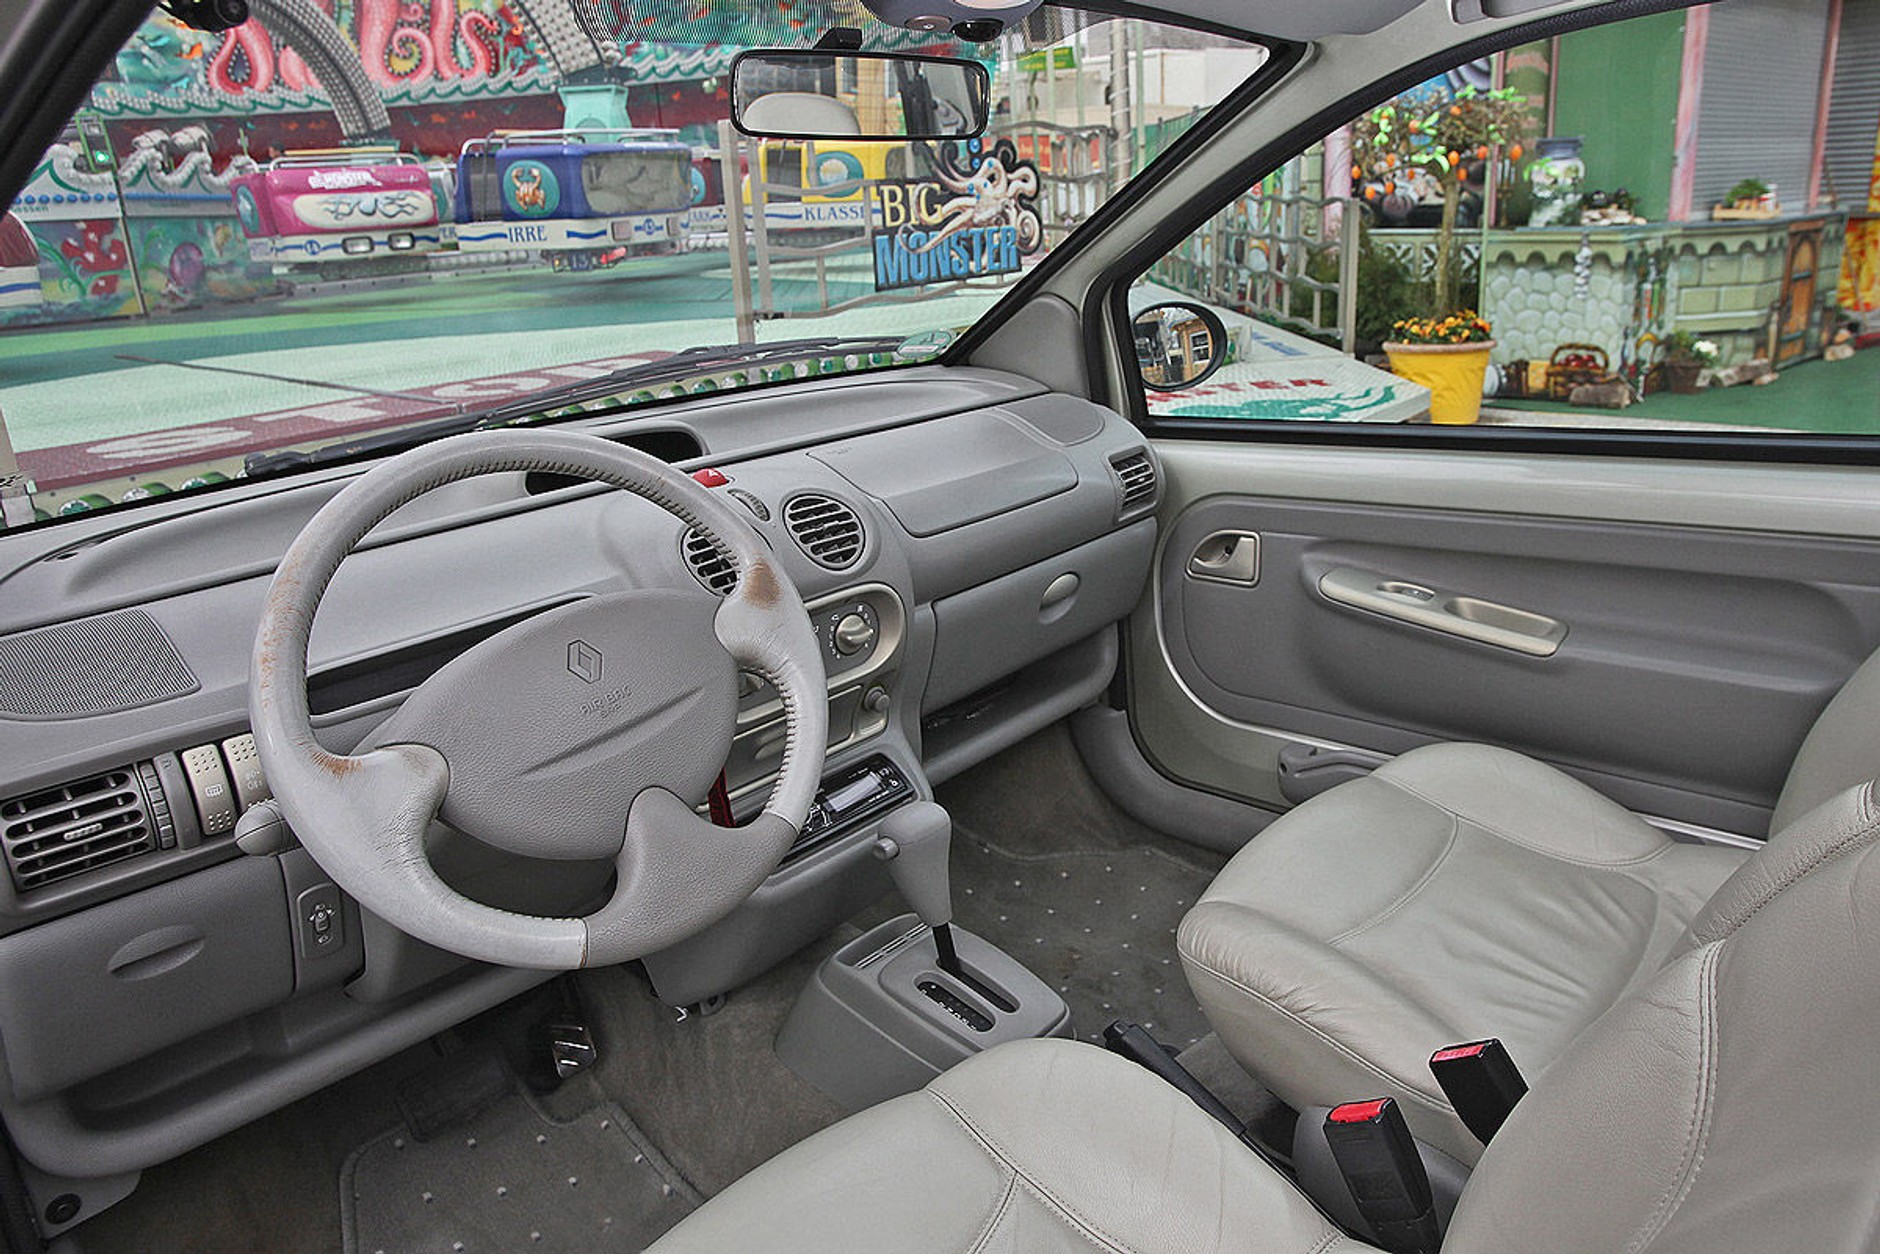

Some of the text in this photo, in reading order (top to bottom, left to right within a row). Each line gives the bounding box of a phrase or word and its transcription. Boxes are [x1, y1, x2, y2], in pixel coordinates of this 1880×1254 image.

[880, 183, 943, 227] BIG
[508, 225, 547, 242] IRRE
[875, 225, 1018, 286] MONSTER
